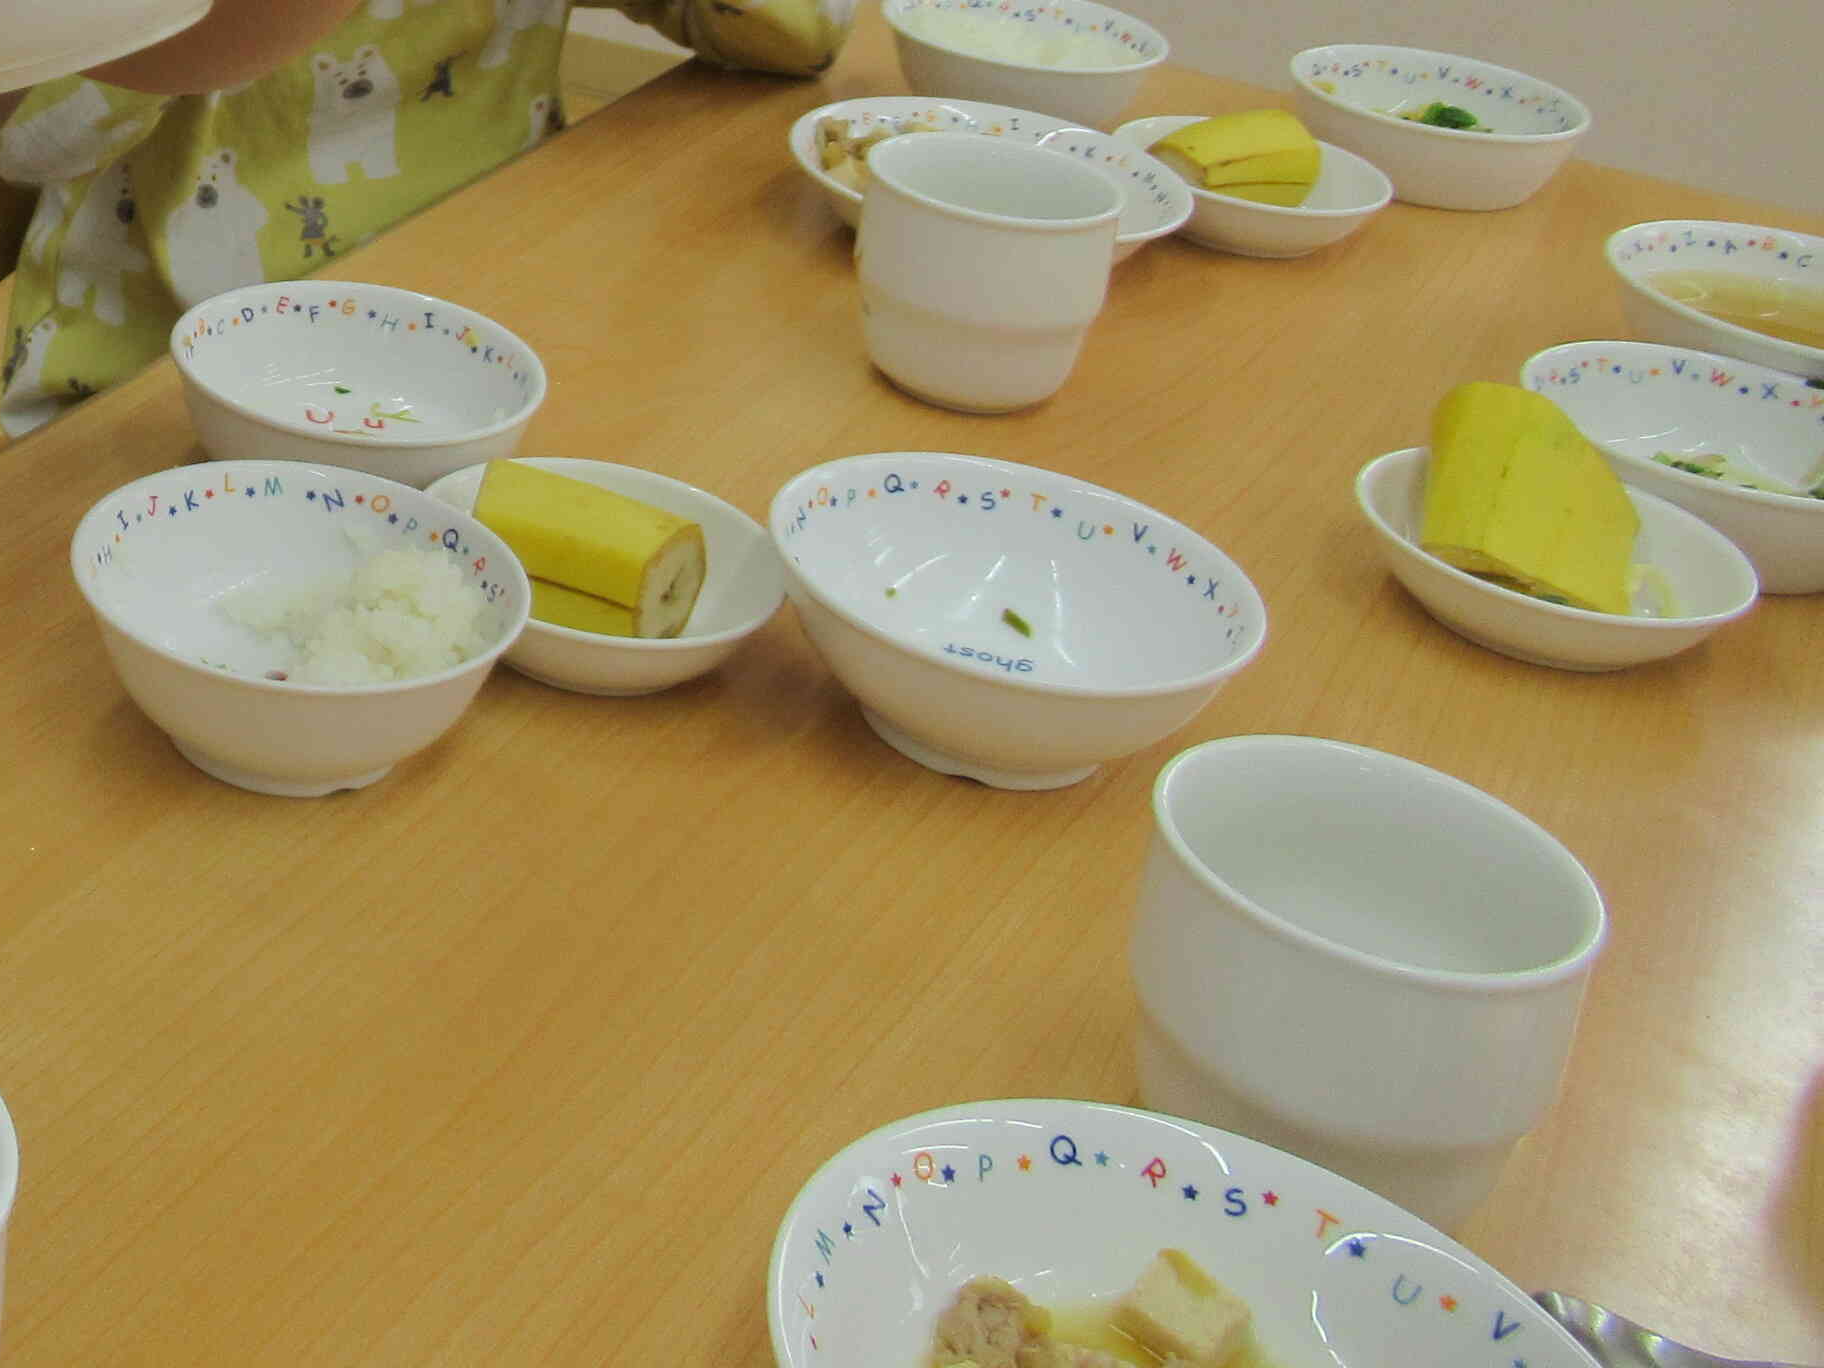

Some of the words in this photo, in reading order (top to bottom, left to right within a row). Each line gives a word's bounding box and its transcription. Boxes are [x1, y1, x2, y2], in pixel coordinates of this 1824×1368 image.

[241, 307, 254, 322] D
[276, 296, 290, 314] E
[309, 305, 320, 322] F
[342, 299, 356, 316] G
[380, 312, 400, 331] H
[424, 313, 434, 328] I
[117, 510, 128, 530] I
[148, 496, 159, 516] J
[184, 489, 199, 511] K
[224, 472, 236, 492] L
[264, 476, 283, 496] M
[322, 489, 345, 512] N
[371, 495, 390, 512] O
[402, 518, 418, 534] P
[442, 528, 459, 552] Q
[884, 473, 905, 494] Q
[933, 480, 951, 499] R
[981, 491, 996, 510] S
[1031, 492, 1047, 511] T
[1078, 521, 1095, 541] U
[1133, 522, 1148, 543] V
[1166, 548, 1188, 572] W
[1203, 578, 1219, 600] X
[944, 643, 1033, 672] ghost
[814, 1228, 836, 1266] M
[862, 1188, 886, 1226] N
[978, 1154, 994, 1182] P
[1049, 1135, 1083, 1166] Q
[1141, 1157, 1167, 1188] R
[1223, 1188, 1248, 1217] S
[1315, 1209, 1341, 1238] T
[1392, 1274, 1422, 1306] U
[1491, 1310, 1521, 1341] V
